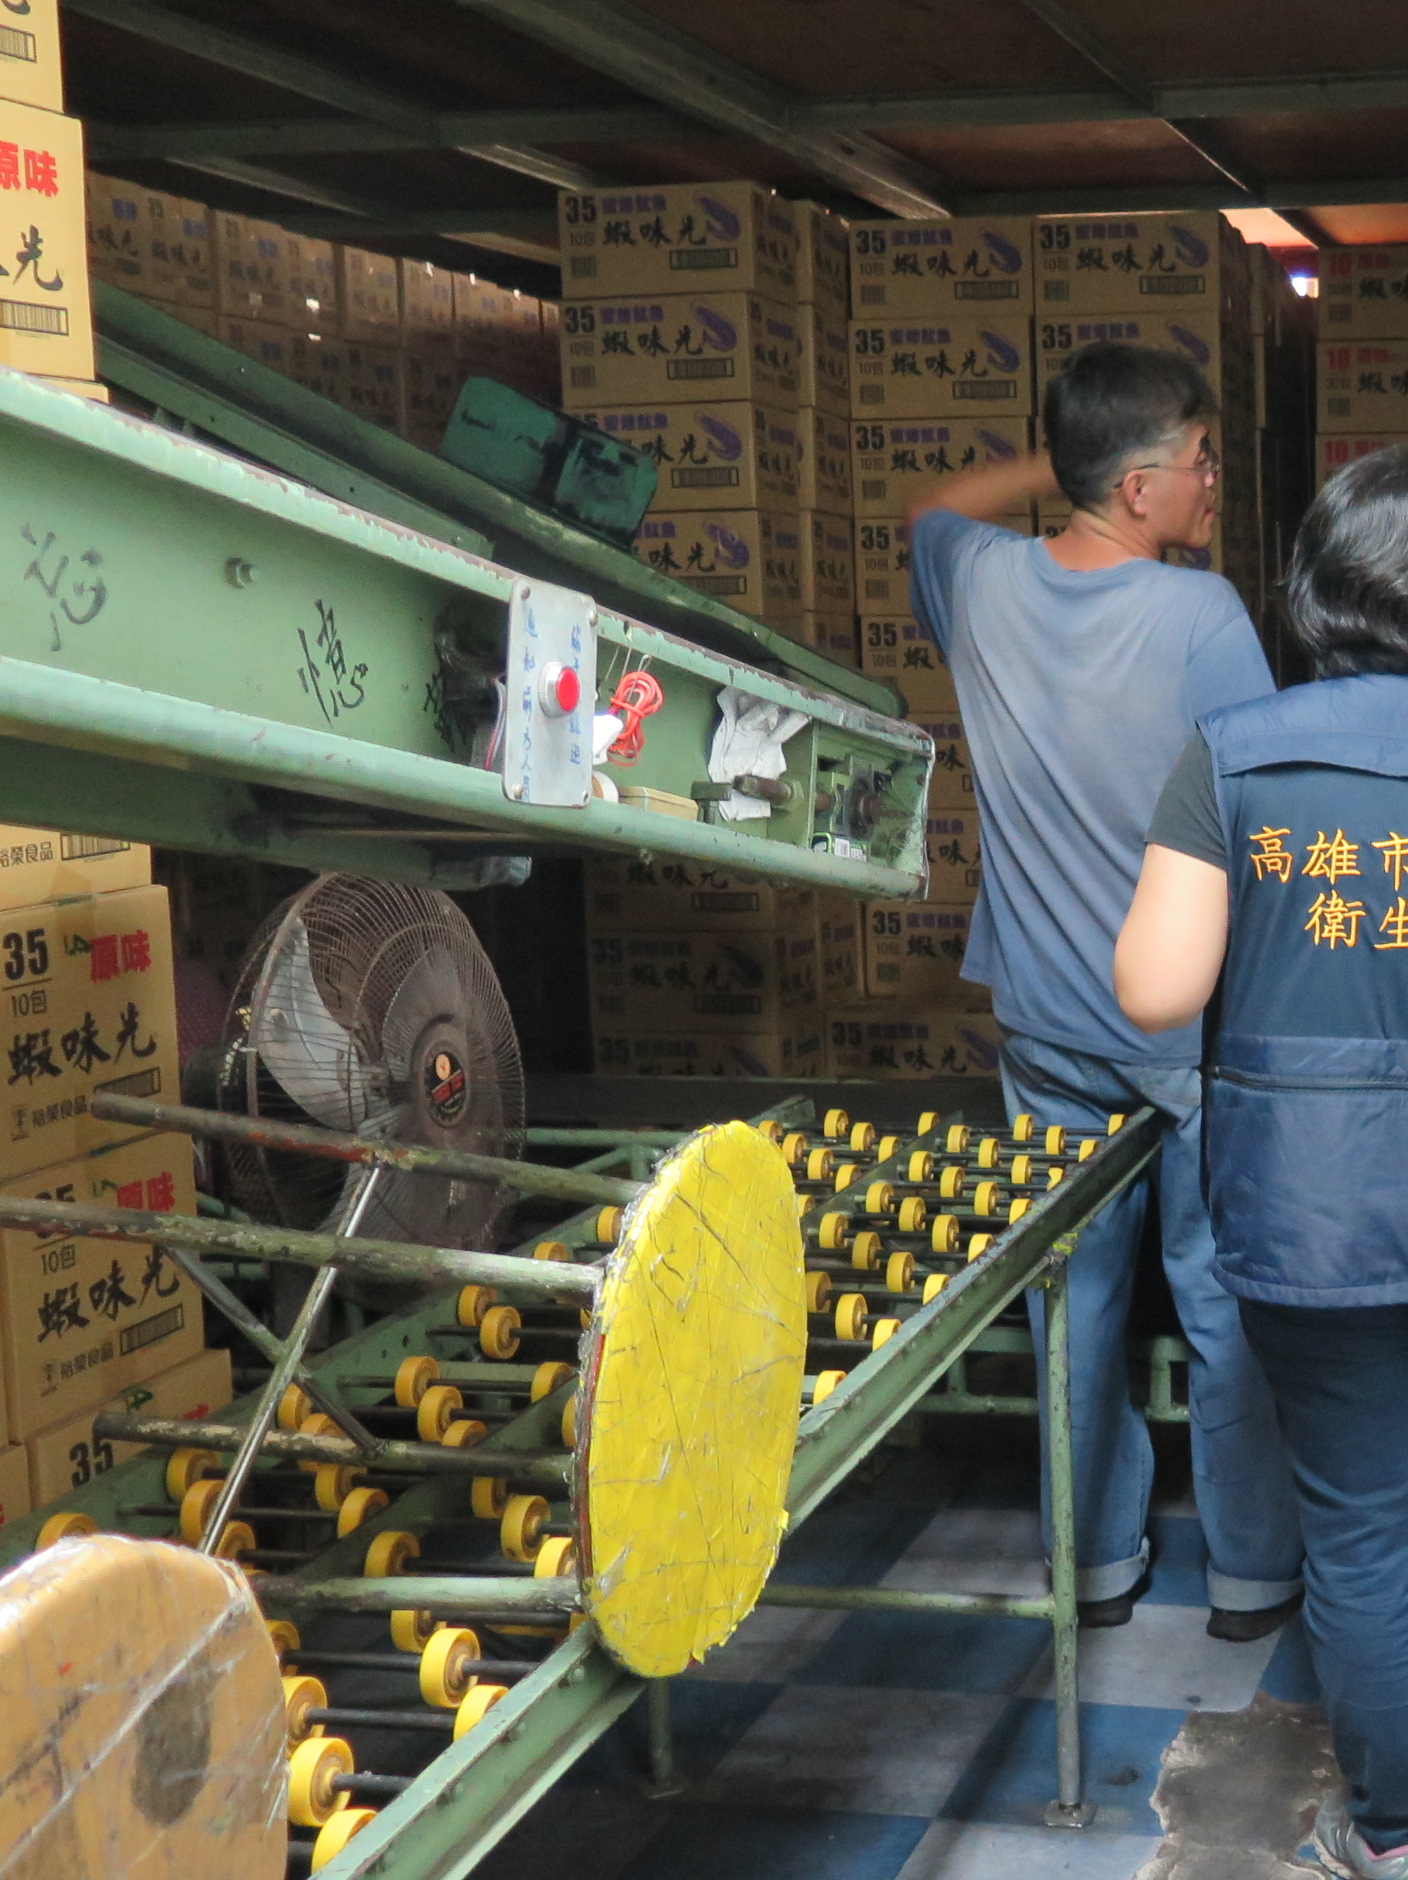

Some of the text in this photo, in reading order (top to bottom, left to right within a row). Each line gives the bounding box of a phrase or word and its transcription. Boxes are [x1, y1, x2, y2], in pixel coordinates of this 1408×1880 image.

[565, 196, 597, 224] 35
[855, 229, 885, 254] 35
[1040, 224, 1070, 250] 35
[565, 305, 595, 333] 35
[855, 329, 884, 355] 35
[1041, 324, 1071, 349] 35
[856, 426, 884, 451] 35
[861, 526, 890, 550] 35
[868, 622, 897, 648] 35
[873, 911, 901, 935] 35
[3, 929, 49, 980] 35
[11, 990, 48, 1017] 10包
[40, 1243, 76, 1275] 10包
[69, 1437, 114, 1488] 35
